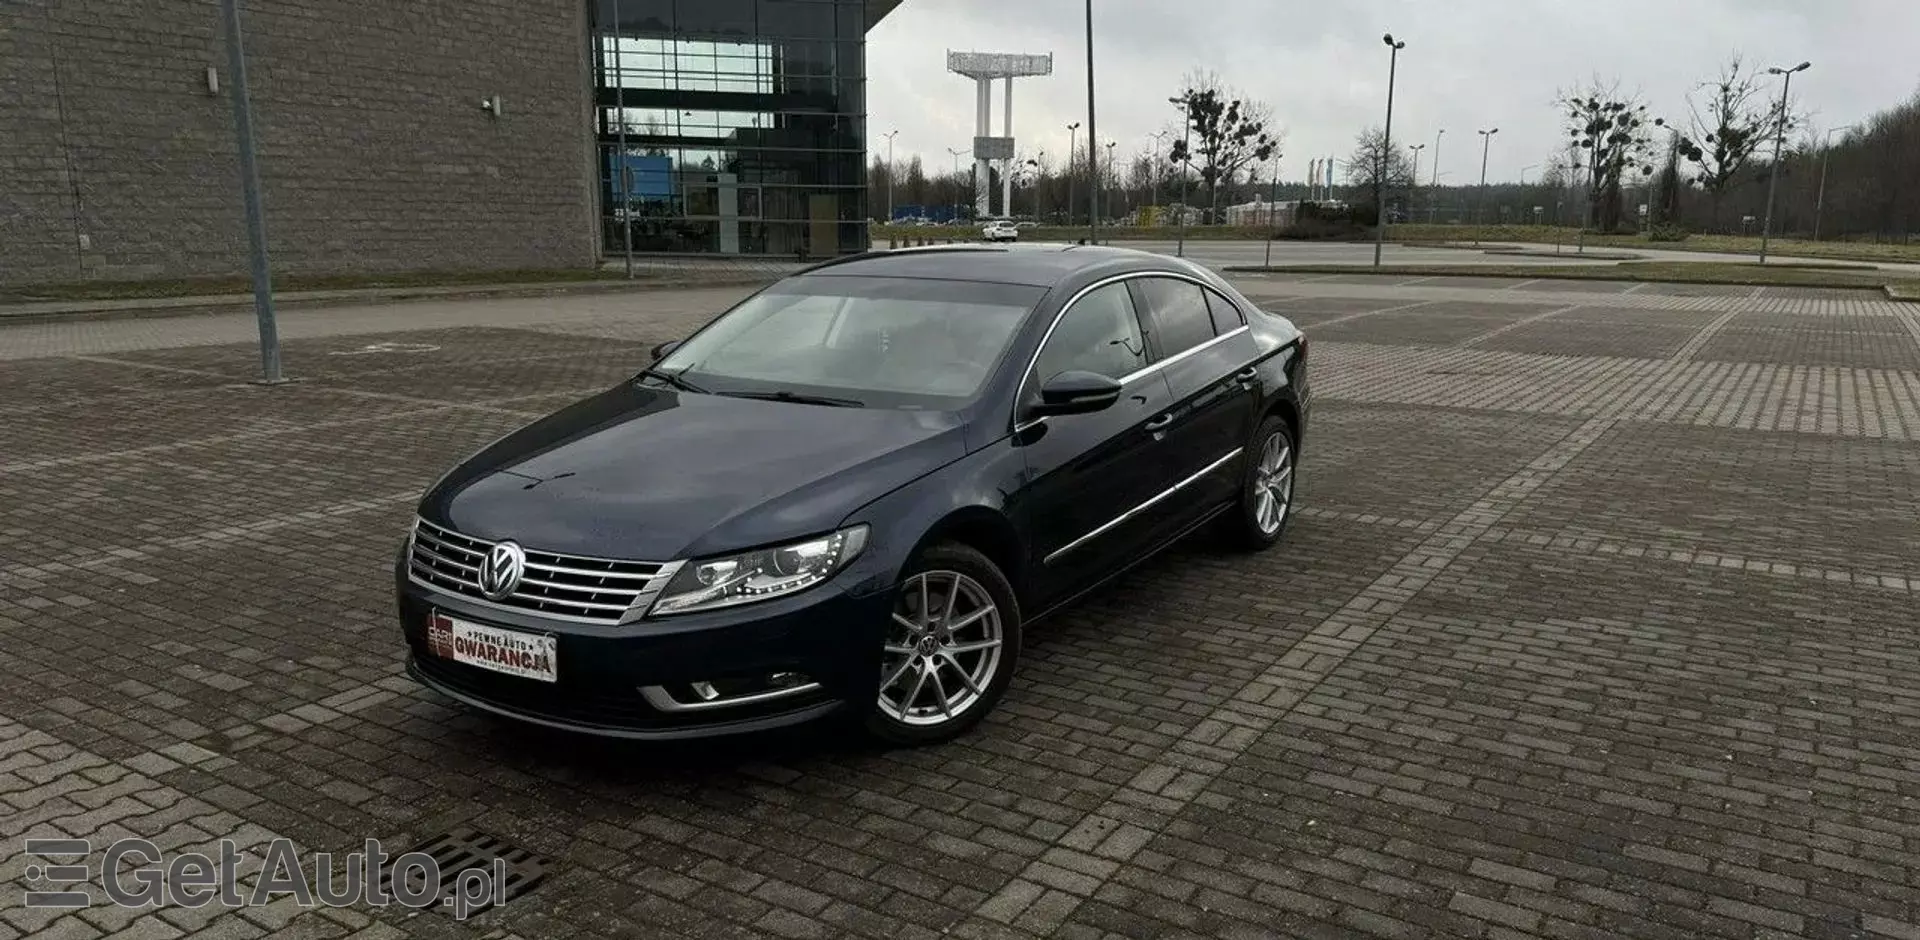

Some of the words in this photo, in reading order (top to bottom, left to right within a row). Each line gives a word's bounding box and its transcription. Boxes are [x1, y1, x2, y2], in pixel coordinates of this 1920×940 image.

[455, 636, 552, 673] GWARANCJA
[473, 631, 501, 646] PEWNE
[504, 637, 526, 651] AUTO
